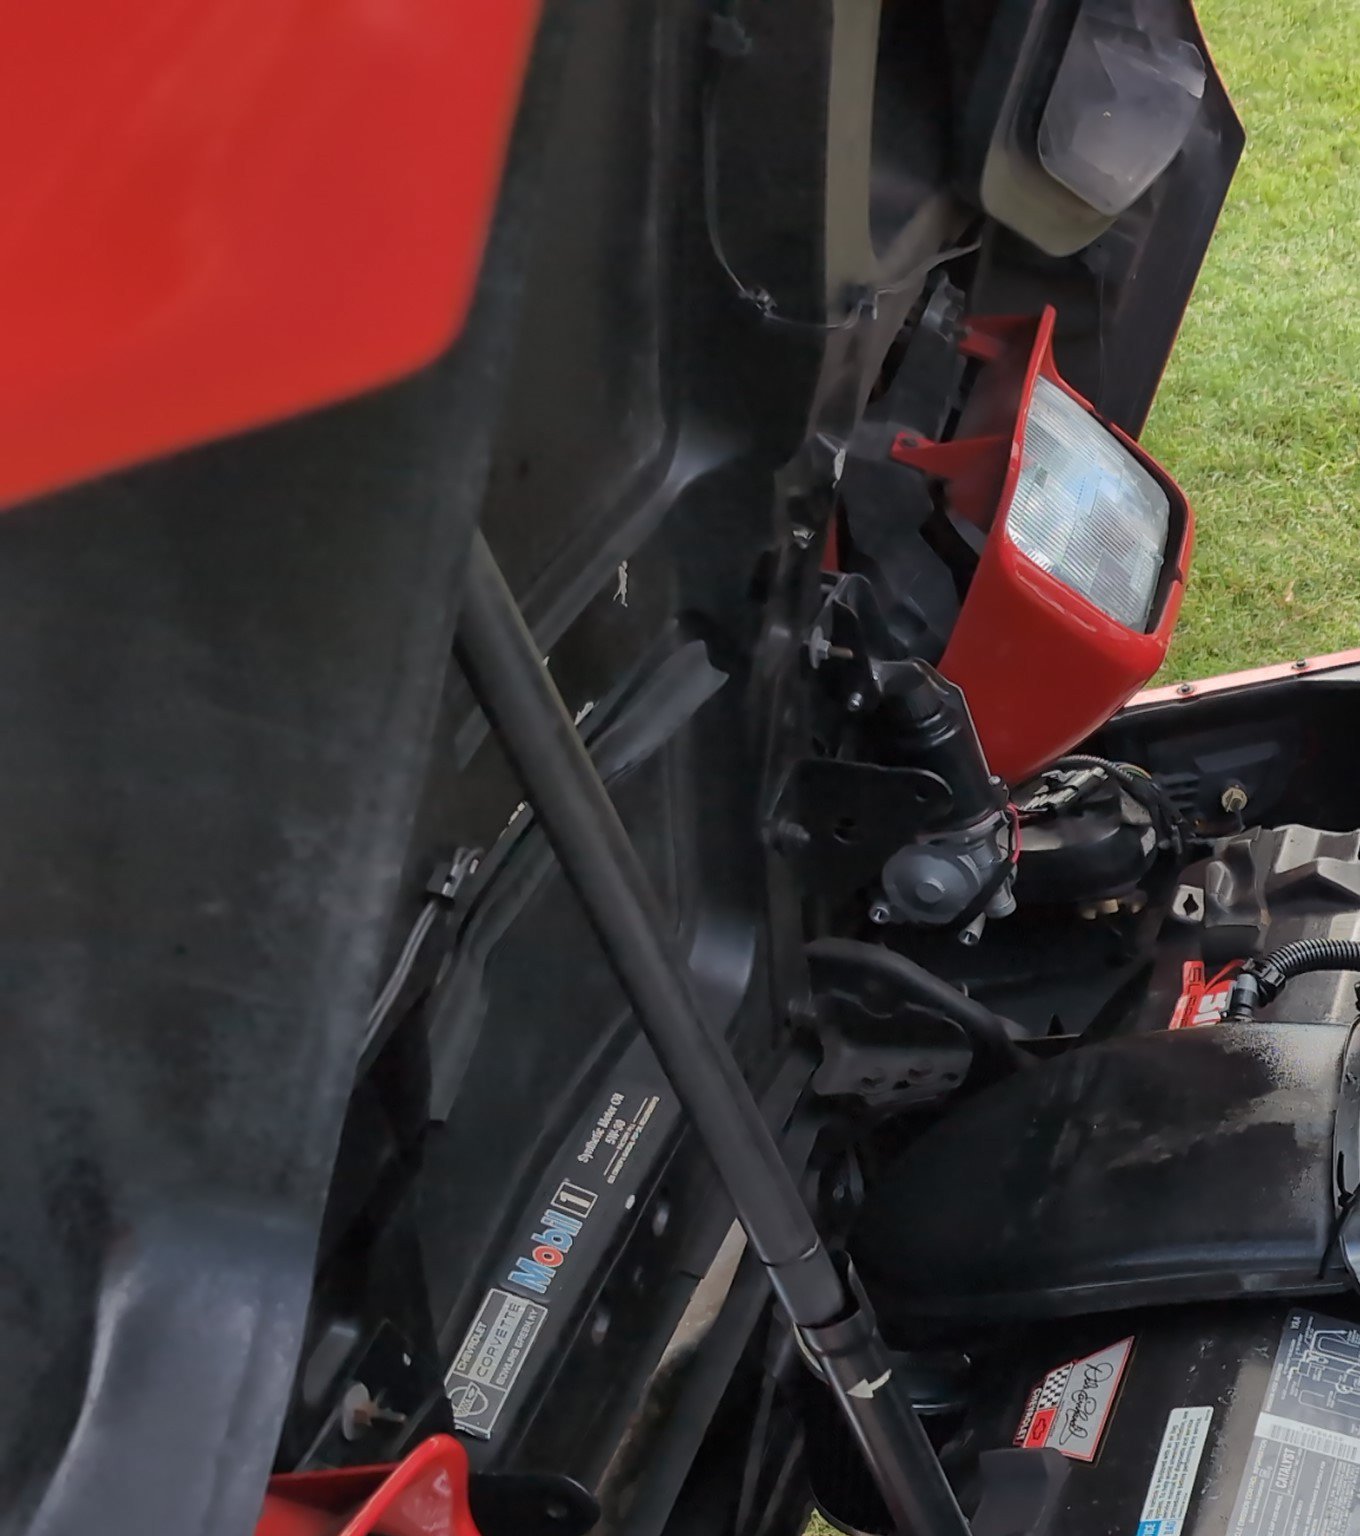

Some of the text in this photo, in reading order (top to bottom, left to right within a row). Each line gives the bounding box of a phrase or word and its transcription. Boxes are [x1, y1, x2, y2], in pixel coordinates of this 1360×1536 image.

[507, 1207, 583, 1294] Mobil
[456, 1321, 487, 1371] CHEVROLET
[475, 1301, 521, 1378] CORVETTE
[1274, 1447, 1296, 1489] CATALYST
